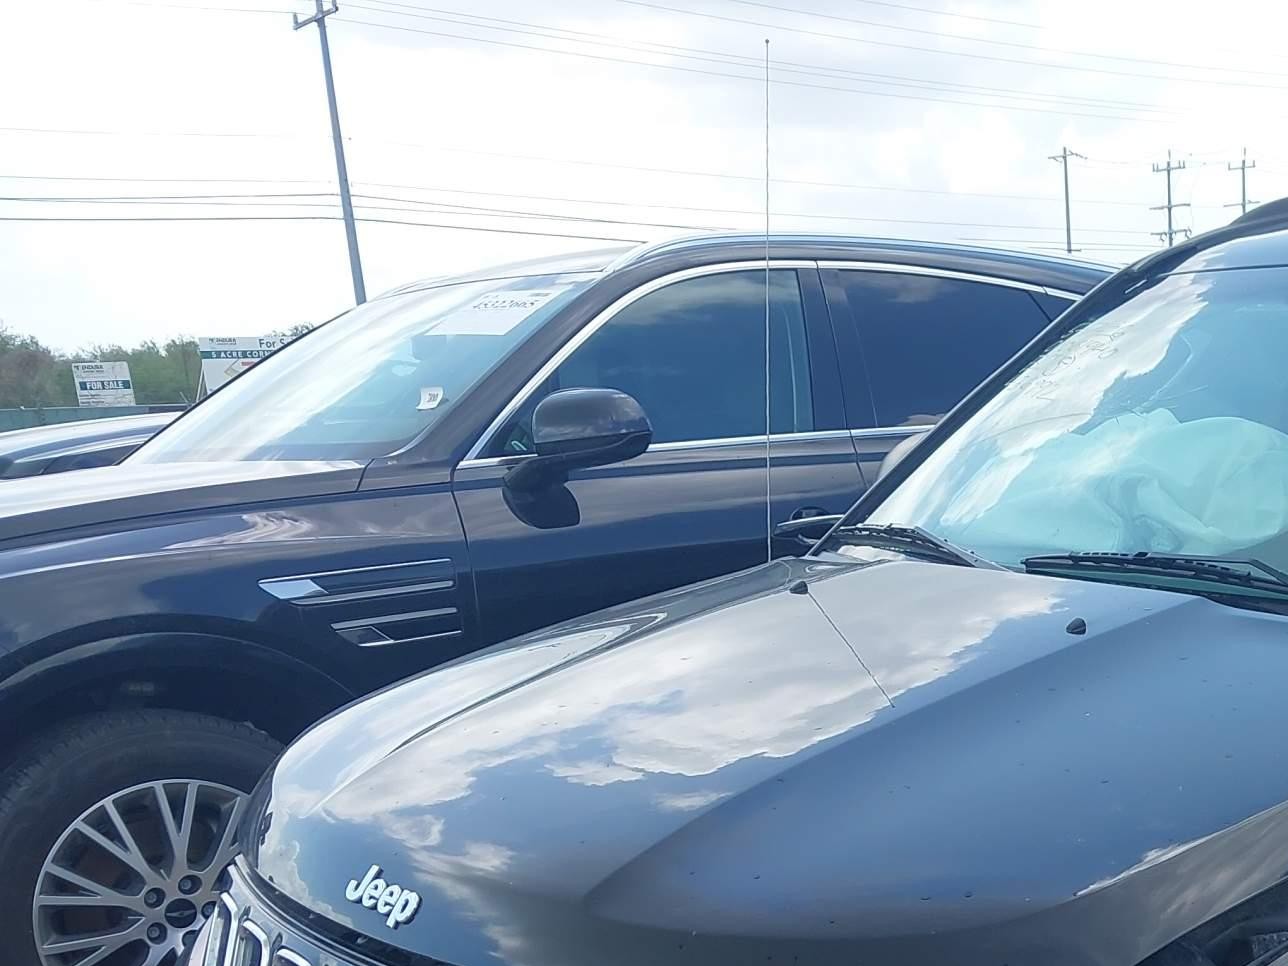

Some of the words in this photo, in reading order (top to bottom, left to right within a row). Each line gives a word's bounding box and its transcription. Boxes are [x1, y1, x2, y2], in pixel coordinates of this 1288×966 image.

[258, 338, 276, 349] For
[86, 381, 103, 390] FOR
[103, 380, 124, 390] SALE
[345, 864, 421, 929] Jeep
